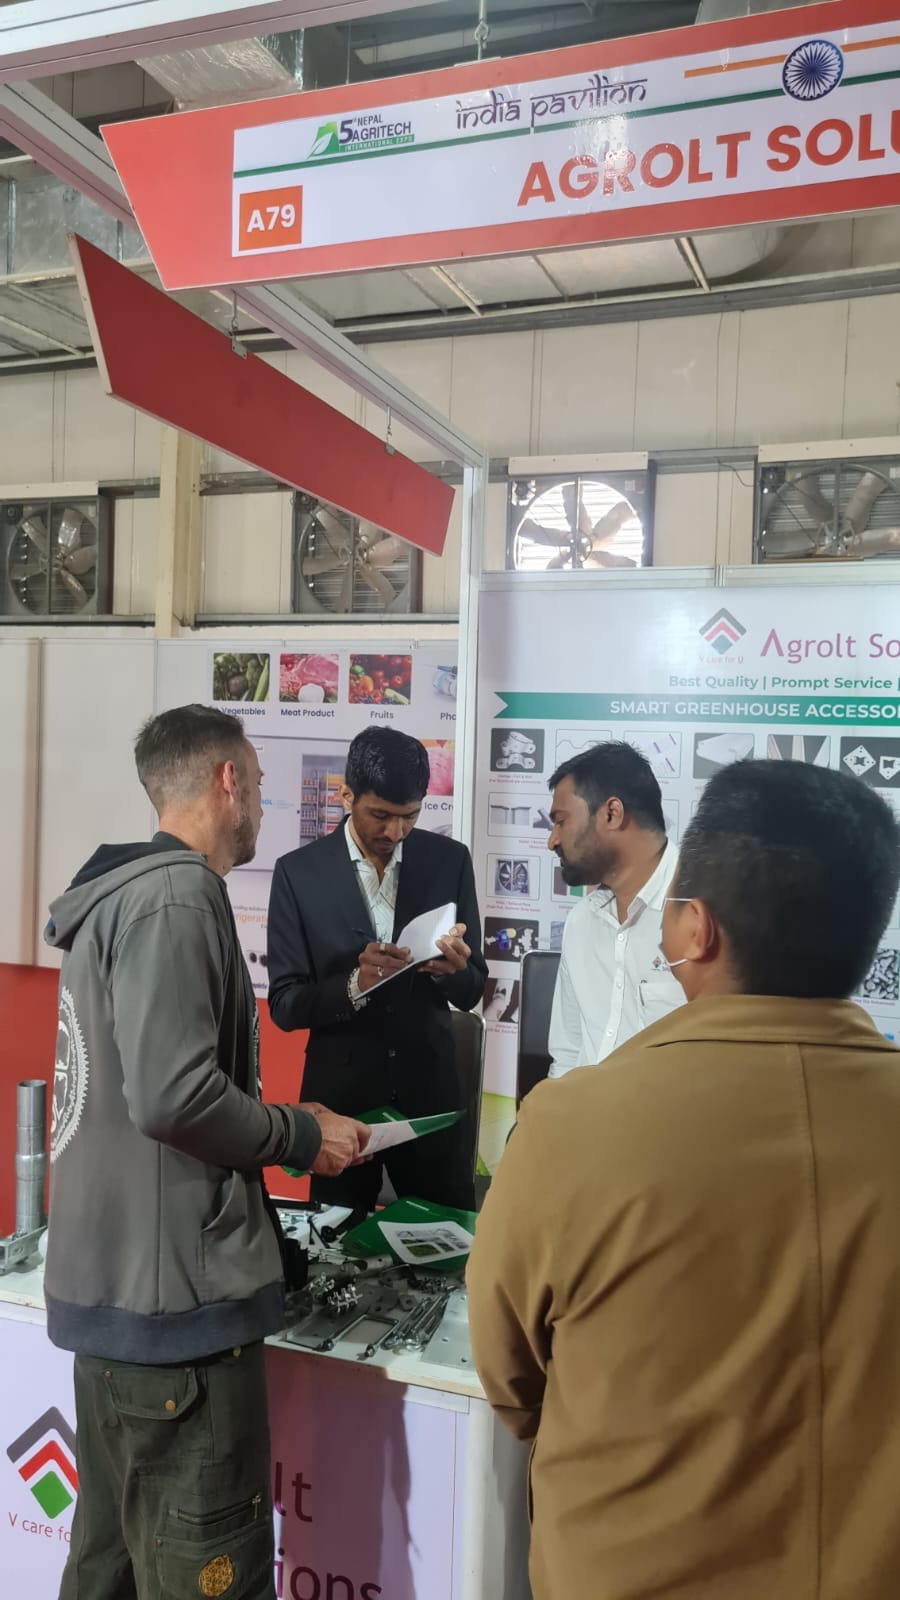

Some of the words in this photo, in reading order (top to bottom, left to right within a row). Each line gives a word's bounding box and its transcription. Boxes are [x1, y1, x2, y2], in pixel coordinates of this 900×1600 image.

[456, 90, 522, 128] india
[530, 74, 648, 128] pavilion
[357, 113, 384, 126] NEPAL
[352, 120, 412, 143] AGRITECH
[345, 138, 394, 152] INTERNATIONAL
[396, 135, 413, 145] EXPO
[517, 132, 751, 207] AGROLT
[767, 109, 900, 173] SOL
[245, 203, 297, 234] A79
[760, 628, 857, 664] Agrolt
[669, 675, 702, 688] Best
[705, 675, 759, 691] Quality
[771, 676, 830, 691] Prompt
[834, 676, 893, 690] Service
[221, 706, 266, 717] Vegetables
[281, 708, 301, 717] Meat
[303, 708, 335, 718] Product
[370, 710, 394, 720] Fruits
[610, 700, 670, 716] SMART
[675, 701, 801, 718] GREENHOUSE
[805, 703, 900, 720] ACCESSO
[424, 801, 438, 811] Ice
[8, 1511, 18, 1527] V
[22, 1519, 53, 1538] care
